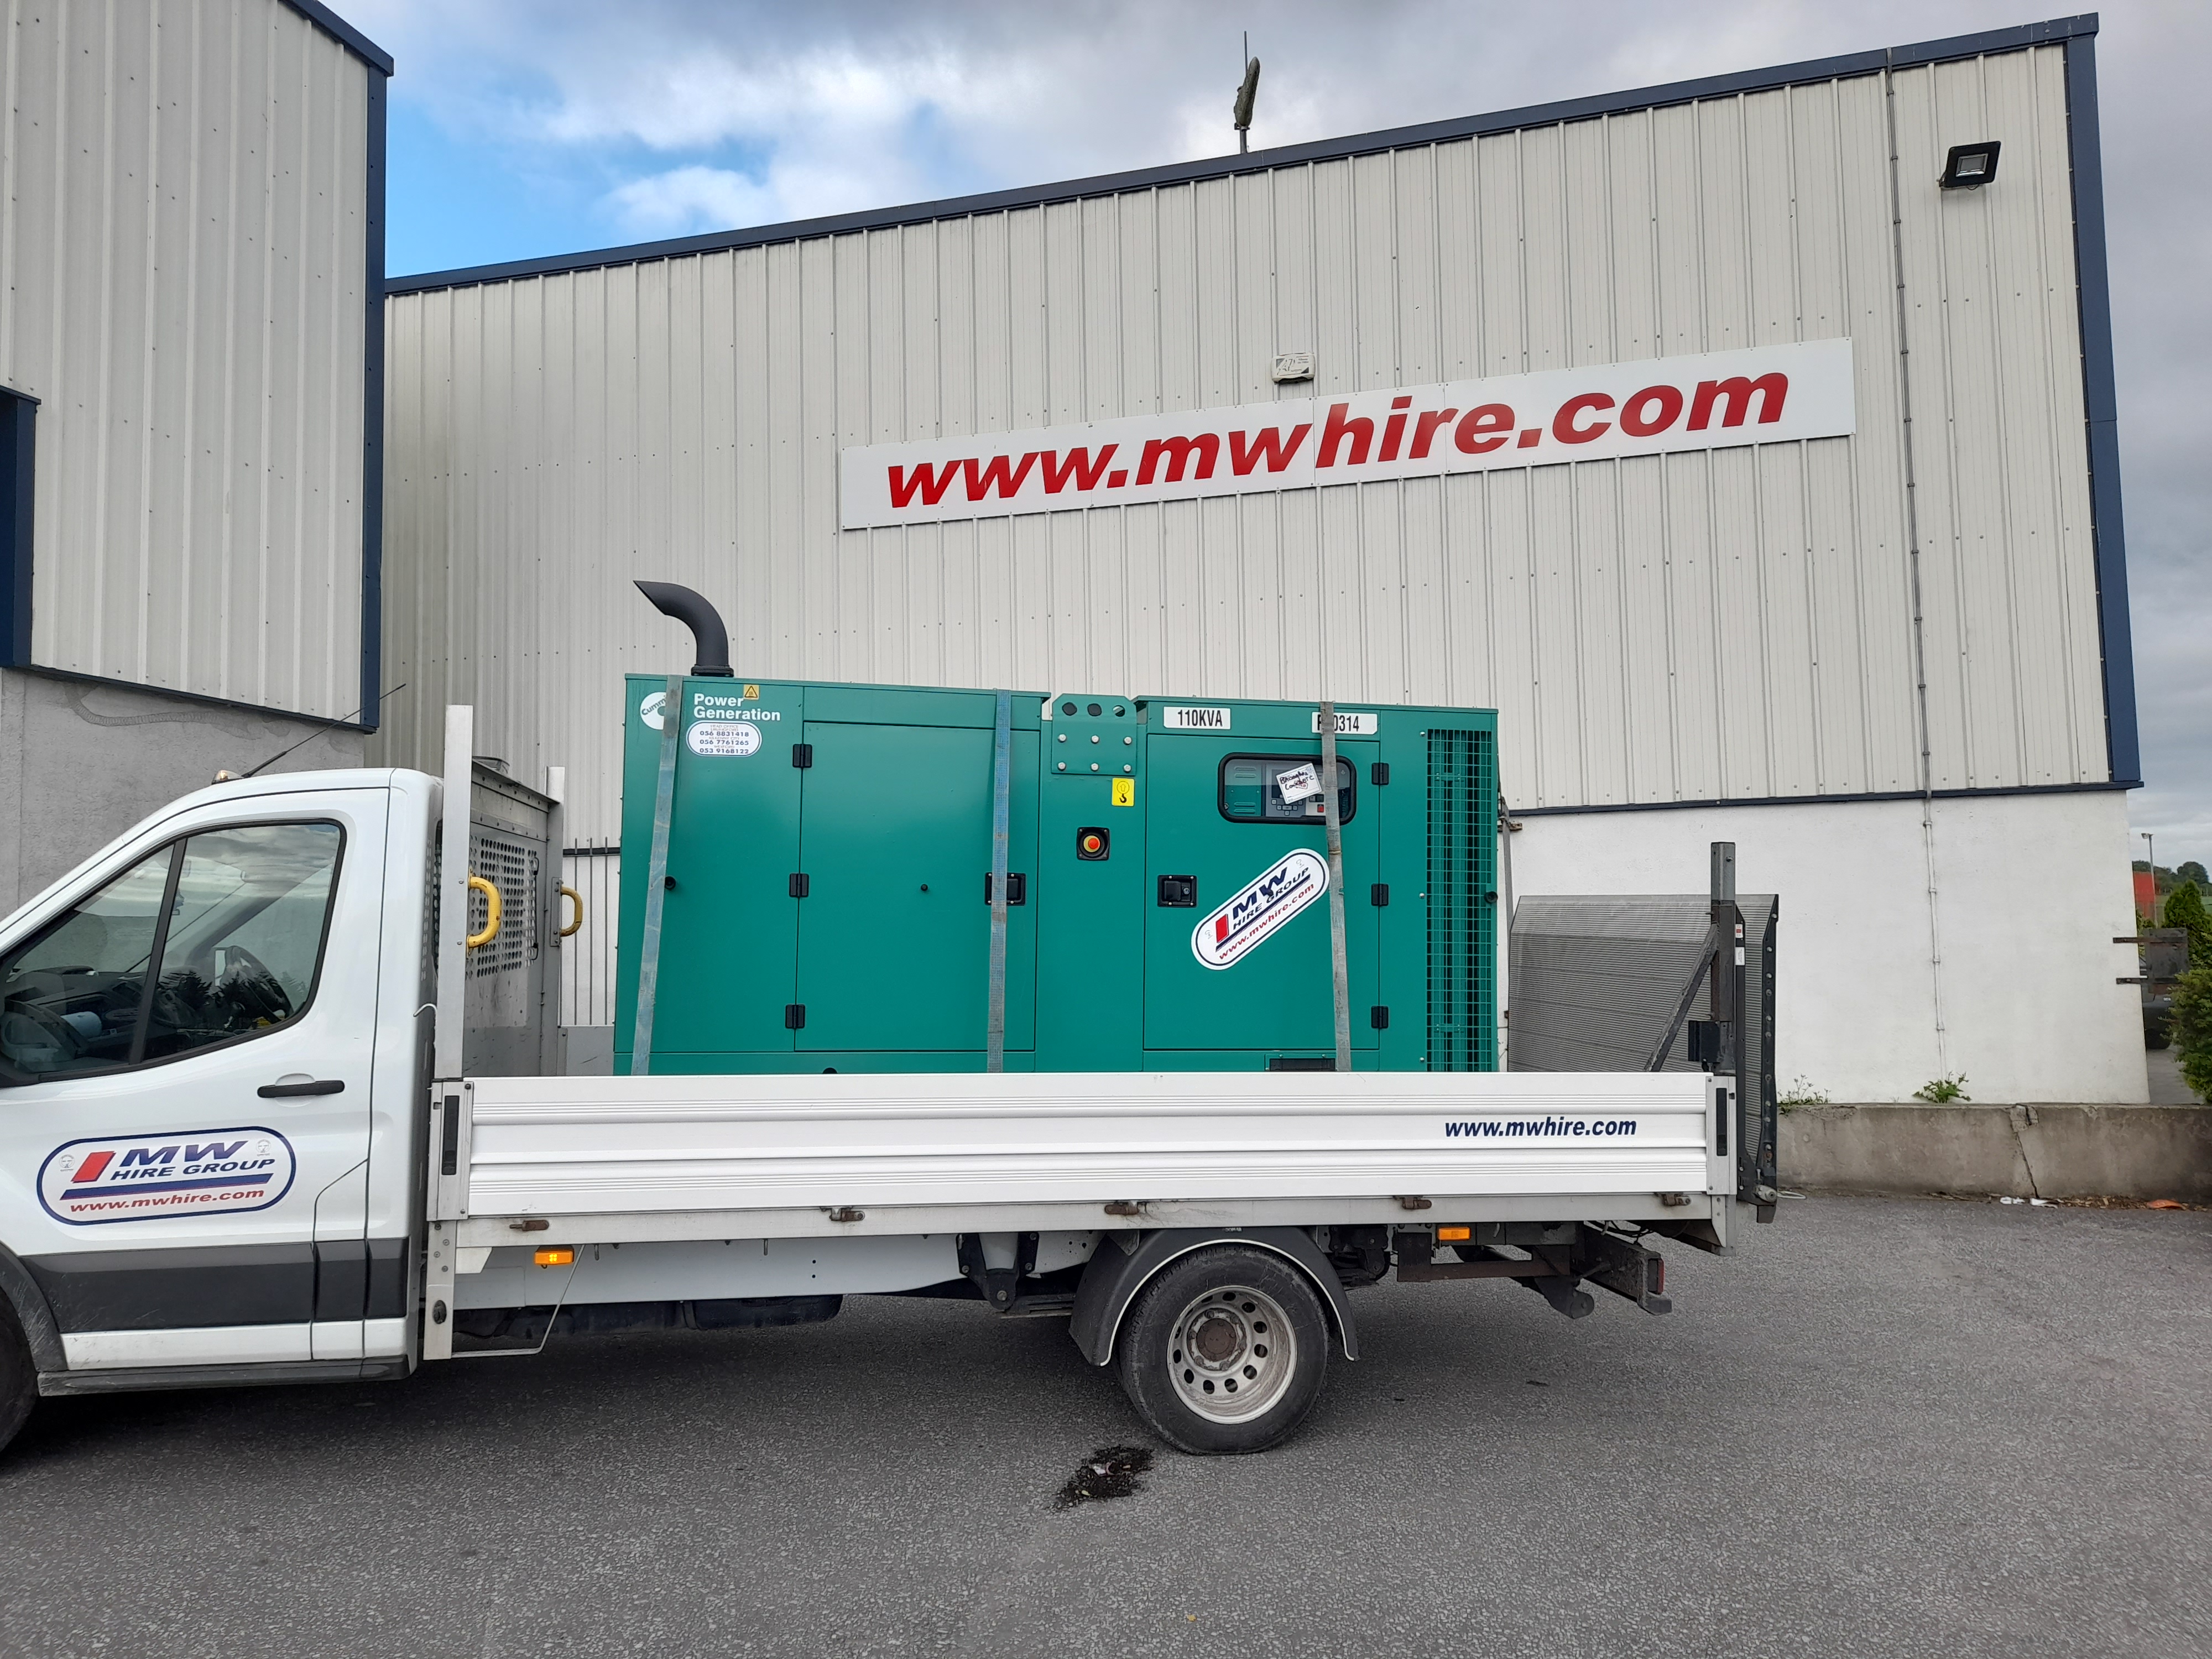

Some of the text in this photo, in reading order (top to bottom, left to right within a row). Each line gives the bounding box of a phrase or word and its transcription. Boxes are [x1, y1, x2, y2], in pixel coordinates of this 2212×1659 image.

[888, 372, 1788, 508] www.mwhire.com
[693, 693, 744, 707] Power
[693, 706, 781, 721] Generation
[1177, 709, 1223, 727] 110KVA
[1233, 866, 1288, 920] MW
[1233, 867, 1309, 930] HIRE GROUP
[1219, 884, 1314, 960] www.mwhire.com
[1445, 1116, 1637, 1137] www.mwhire.com
[119, 1140, 249, 1167] MW
[110, 1159, 275, 1180] HIRE GROUP
[70, 1190, 264, 1212] www.mwhire.com
